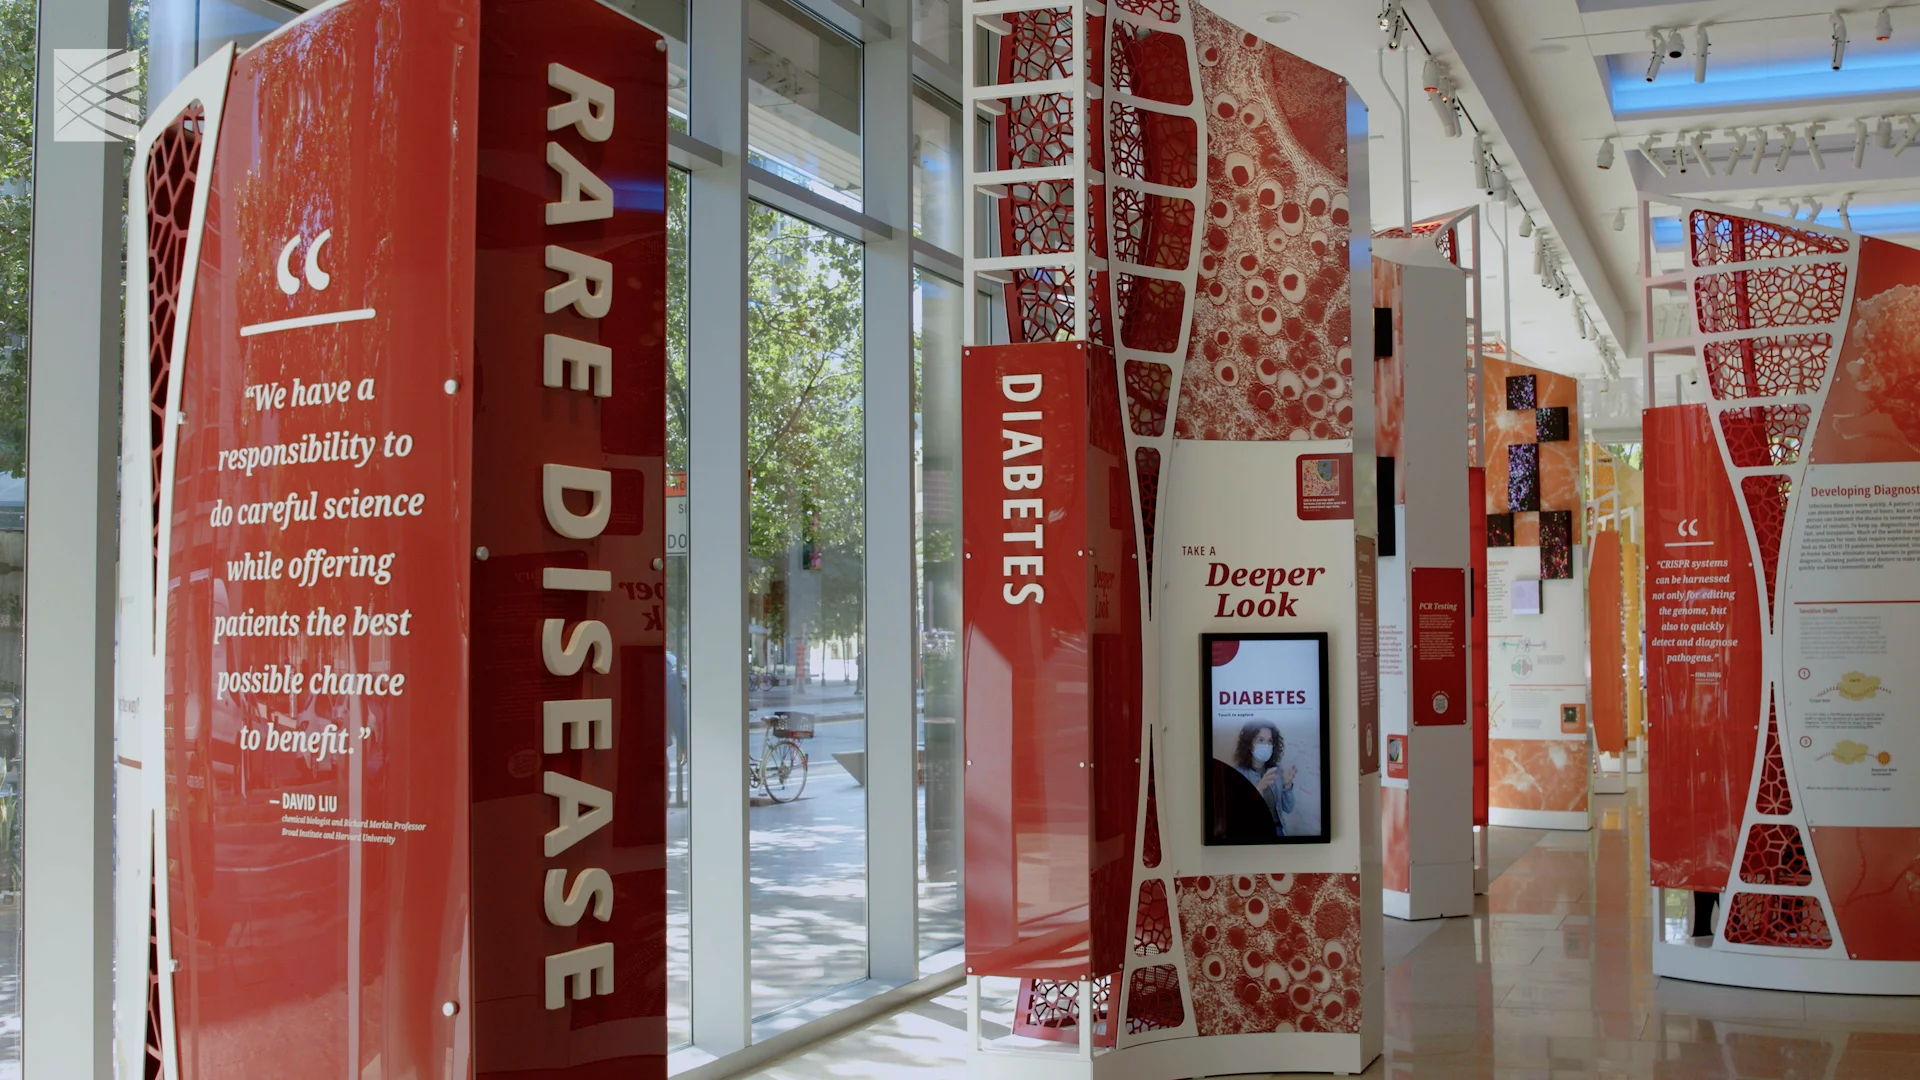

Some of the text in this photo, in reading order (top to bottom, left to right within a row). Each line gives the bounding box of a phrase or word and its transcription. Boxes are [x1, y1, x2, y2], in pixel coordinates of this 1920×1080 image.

[291, 378, 351, 407] have
[357, 378, 375, 401] a
[218, 430, 413, 477] responsibility to
[1002, 373, 1045, 605] DIABETES
[1811, 484, 1920, 499] Developing Diagnost
[210, 488, 425, 531] do careful science
[542, 62, 615, 1011] RARE DISEASE
[1182, 546, 1216, 556] TAKE A
[227, 547, 396, 587] while offering
[1691, 560, 1728, 570] systems
[1205, 562, 1326, 594] Deeper
[1655, 574, 1730, 585] can be harnessed
[1214, 592, 1299, 617] Look
[1652, 589, 1736, 602] not only for editing
[1419, 602, 1458, 612] PCR Testing
[1659, 606, 1727, 617] the genome, but
[213, 606, 412, 645] patients the best
[1661, 622, 1724, 633] also to quickly
[1652, 638, 1738, 648] detect and diagnose
[216, 664, 405, 700] possible chance
[1219, 690, 1306, 705] DIABETES
[240, 725, 261, 751] to
[282, 792, 315, 811] DAVID
[318, 794, 338, 813] LIU
[281, 815, 427, 832] chemical biologist and Richard Merkin Professor
[281, 827, 396, 845] Broad Institute and Harvard University
